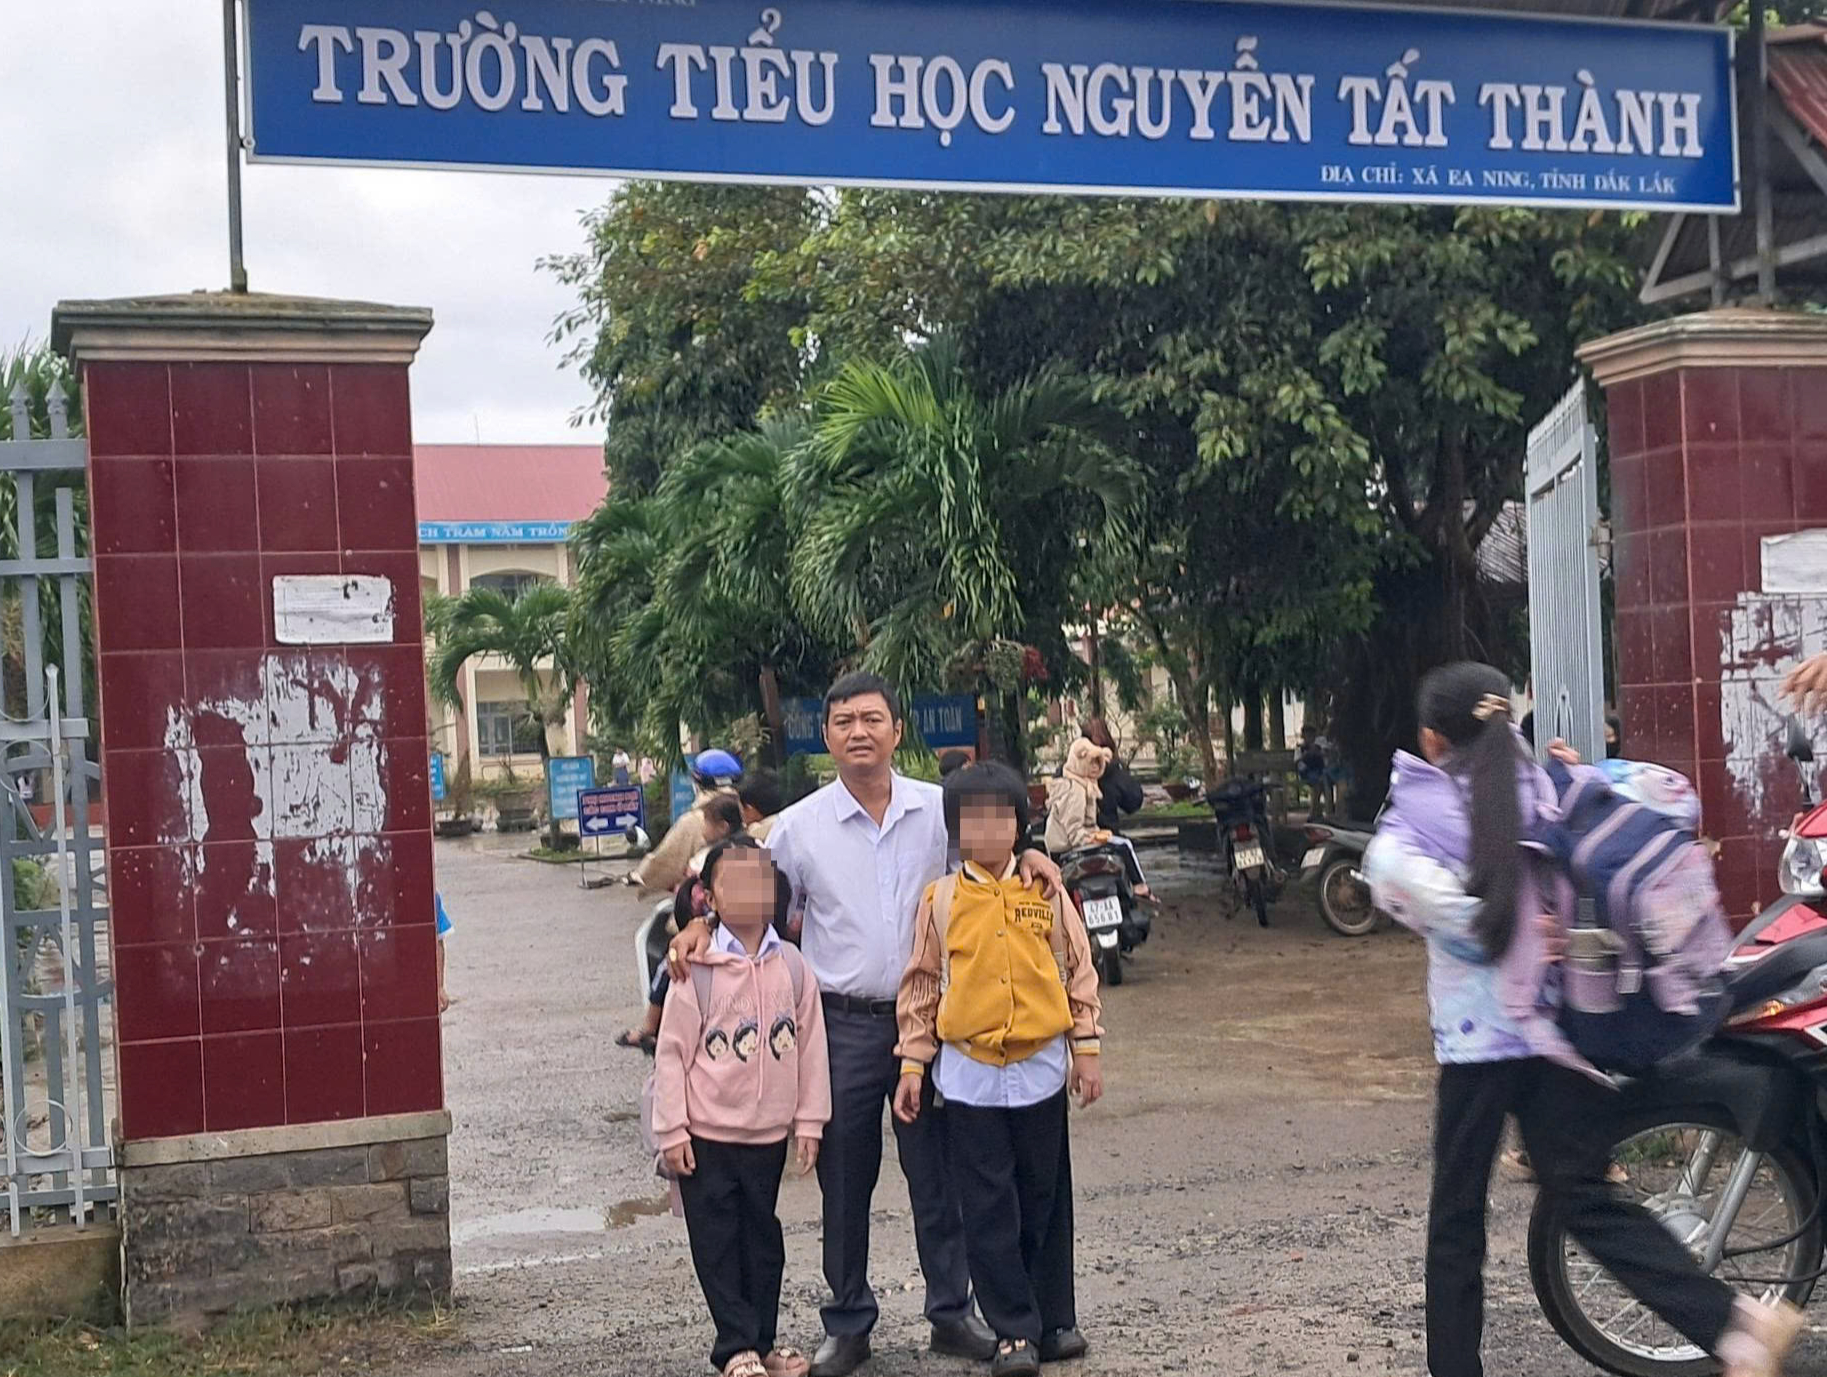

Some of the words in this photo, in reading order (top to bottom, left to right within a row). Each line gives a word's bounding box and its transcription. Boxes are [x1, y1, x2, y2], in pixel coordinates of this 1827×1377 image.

[298, 13, 628, 115] TRƯỜNG
[657, 10, 839, 125] TIỂU
[869, 55, 1016, 147] HỌC
[1042, 39, 1315, 143] NGUYỄN
[1338, 50, 1456, 147] TẤT
[1479, 69, 1703, 158] THÀNH
[1362, 162, 1404, 184] CHỈ:
[1448, 169, 1474, 186] EA
